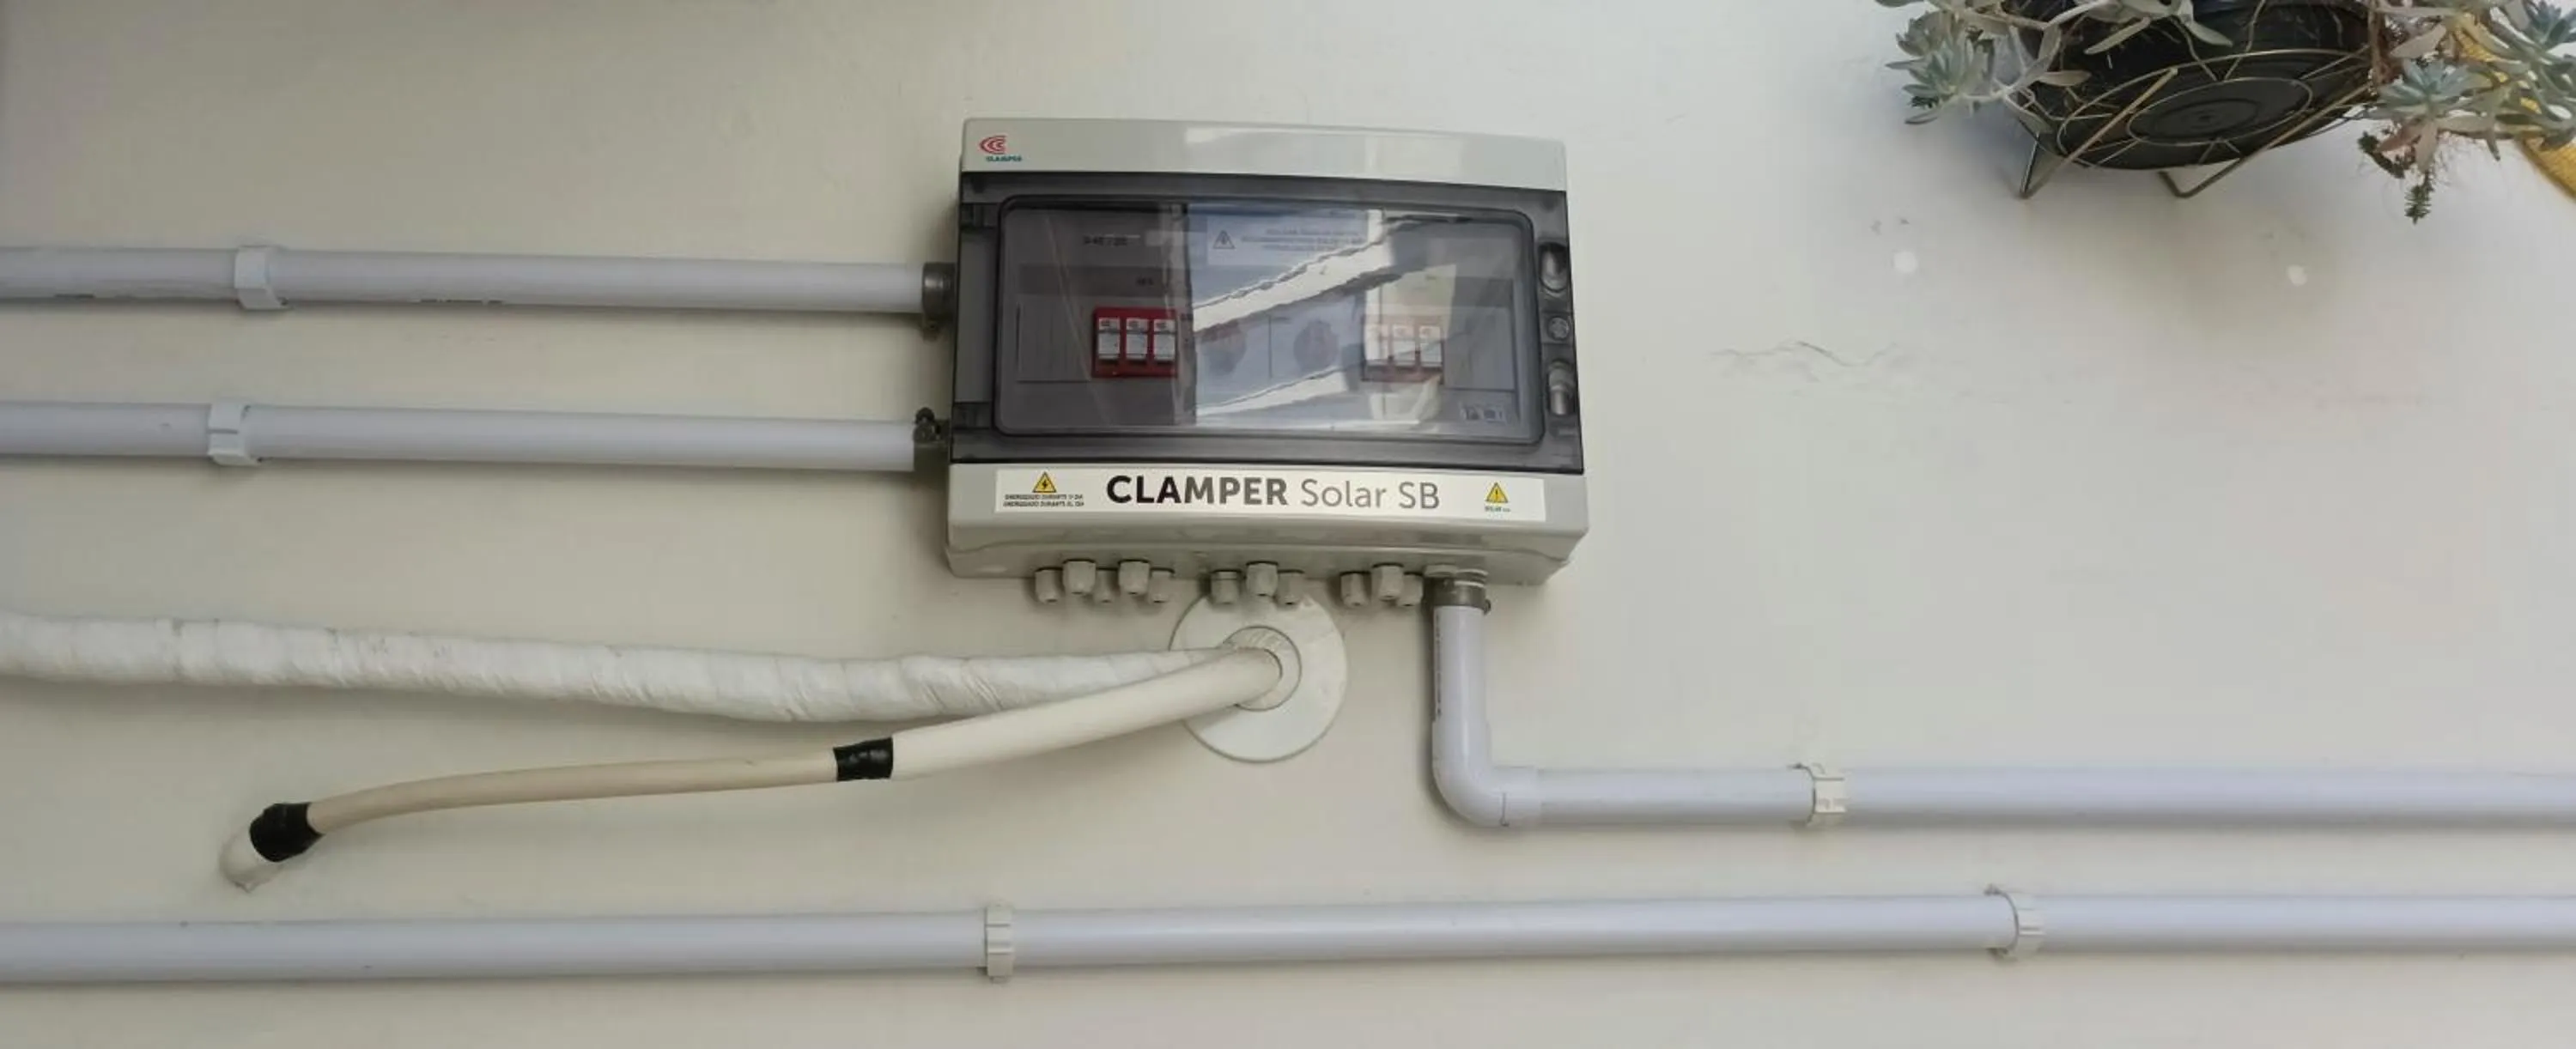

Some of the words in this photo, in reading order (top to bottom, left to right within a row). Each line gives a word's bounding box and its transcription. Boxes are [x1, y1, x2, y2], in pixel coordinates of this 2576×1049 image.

[1106, 476, 1288, 505] CLAMPER
[1300, 479, 1388, 508] Solar
[1399, 482, 1440, 509] SB
